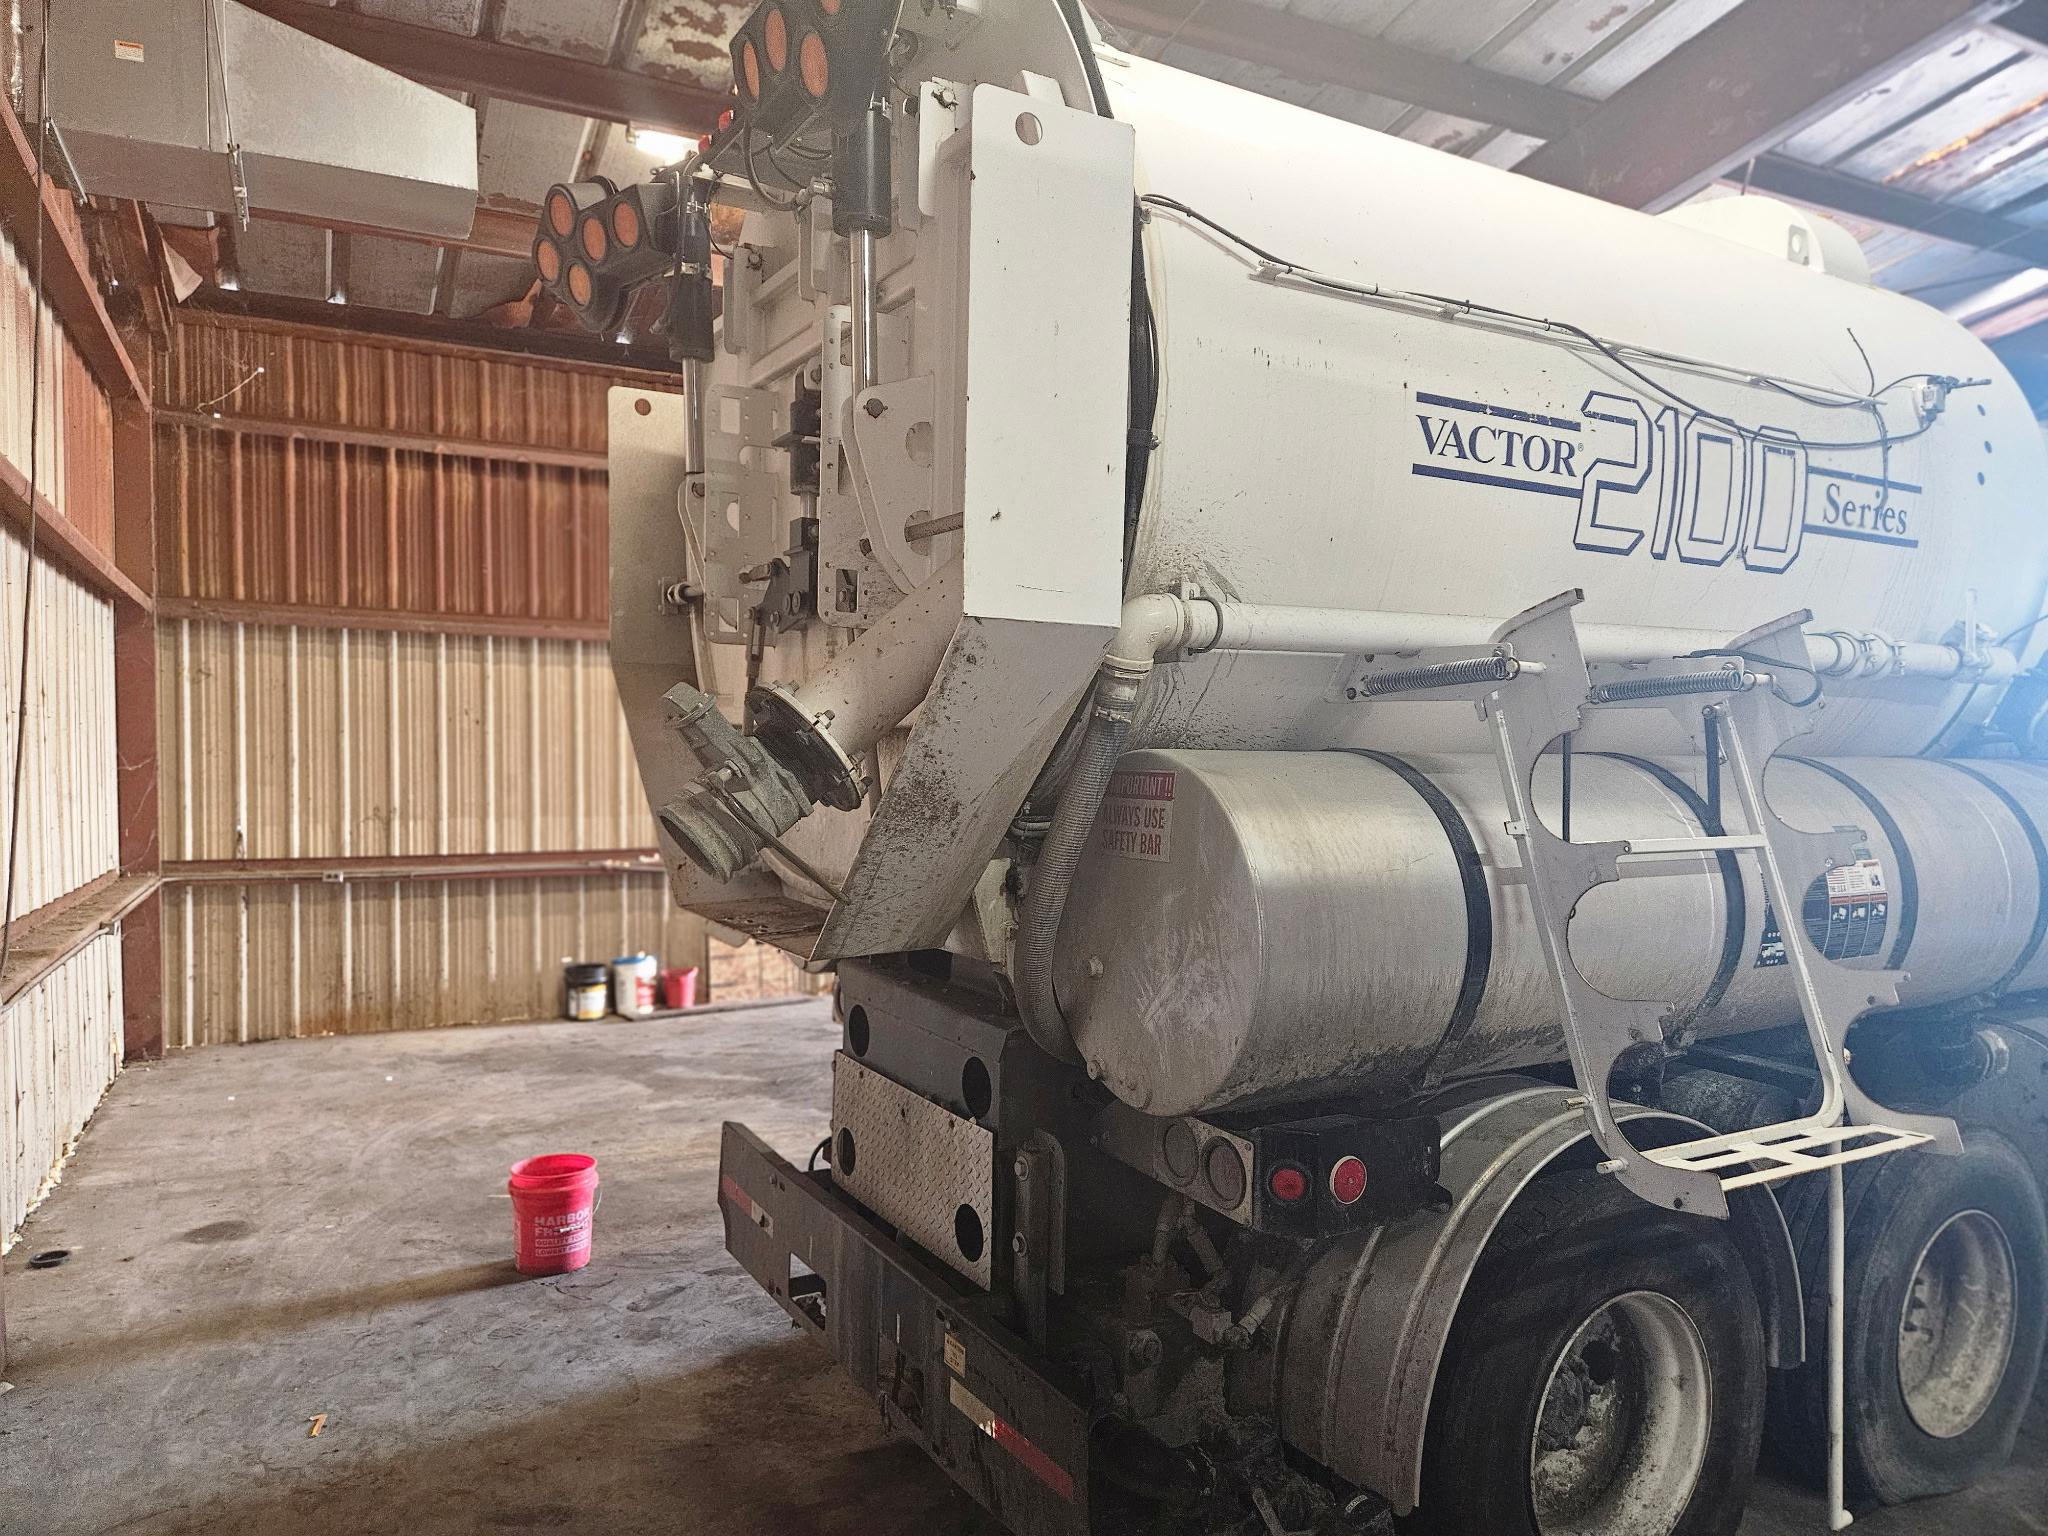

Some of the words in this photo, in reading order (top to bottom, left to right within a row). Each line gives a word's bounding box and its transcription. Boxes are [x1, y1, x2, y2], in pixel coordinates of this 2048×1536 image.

[1573, 390, 1808, 574] 2100
[1822, 483, 1908, 535] Series
[1143, 807, 1167, 829] USE
[1102, 829, 1138, 853] SAFETY
[1139, 832, 1162, 856] BAR
